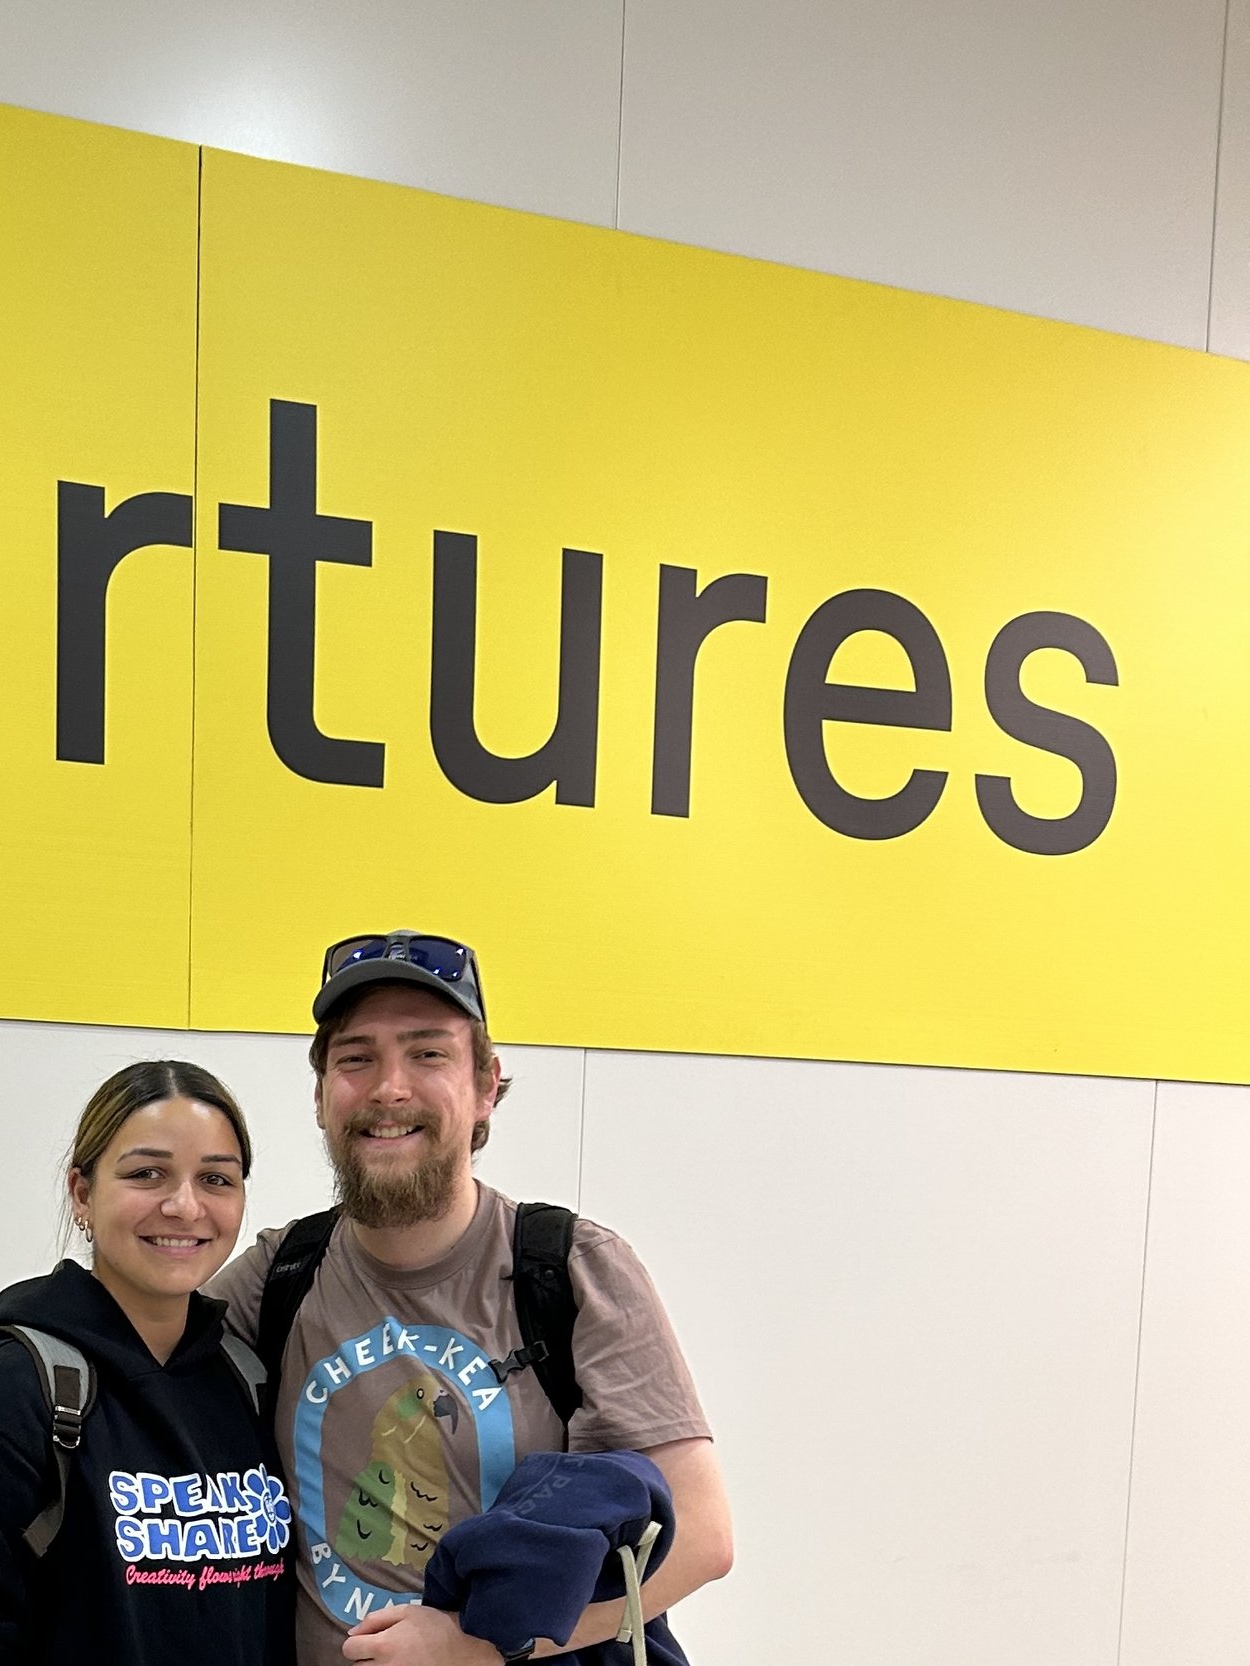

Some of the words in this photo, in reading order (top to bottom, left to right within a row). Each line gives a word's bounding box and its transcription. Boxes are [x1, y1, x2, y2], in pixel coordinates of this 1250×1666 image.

[305, 1323, 503, 1411] CHEEK-KEA
[109, 1471, 247, 1517] SPEAK
[115, 1516, 262, 1562] SHARE
[126, 1564, 196, 1590] Creativity
[311, 1542, 347, 1588] BY
